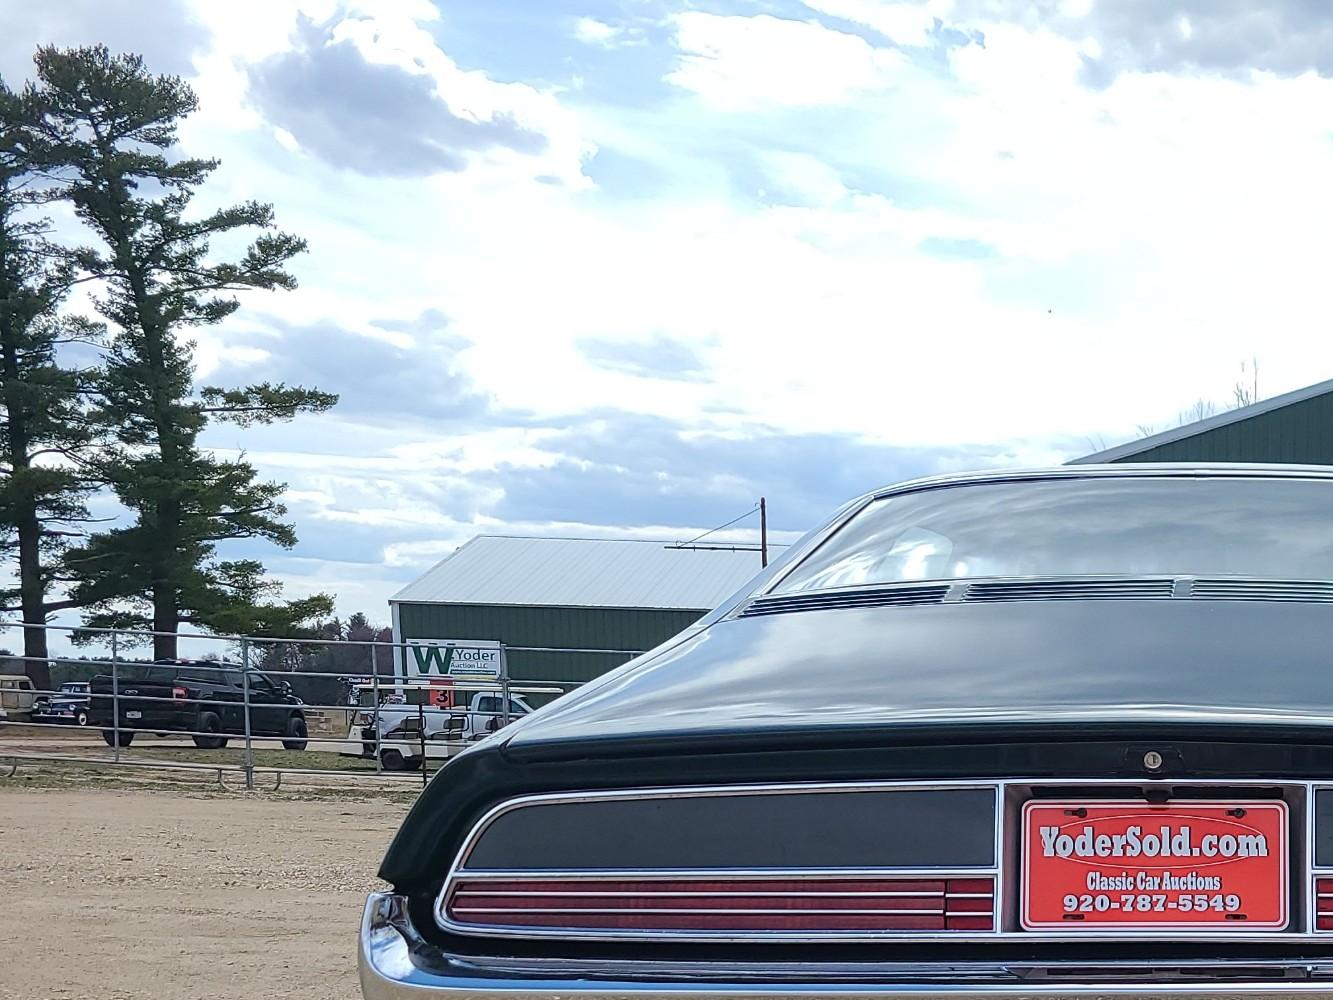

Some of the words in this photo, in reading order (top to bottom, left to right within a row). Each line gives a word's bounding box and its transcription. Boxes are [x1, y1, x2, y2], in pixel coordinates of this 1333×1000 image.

[455, 648, 496, 661] Yoder
[436, 688, 449, 703] 3
[1039, 826, 1268, 857] YoderSold.com
[1086, 871, 1134, 891] Classic
[1136, 871, 1161, 891] Car
[1162, 871, 1222, 891] Auctions
[1063, 894, 1240, 912] 920-787-5549
